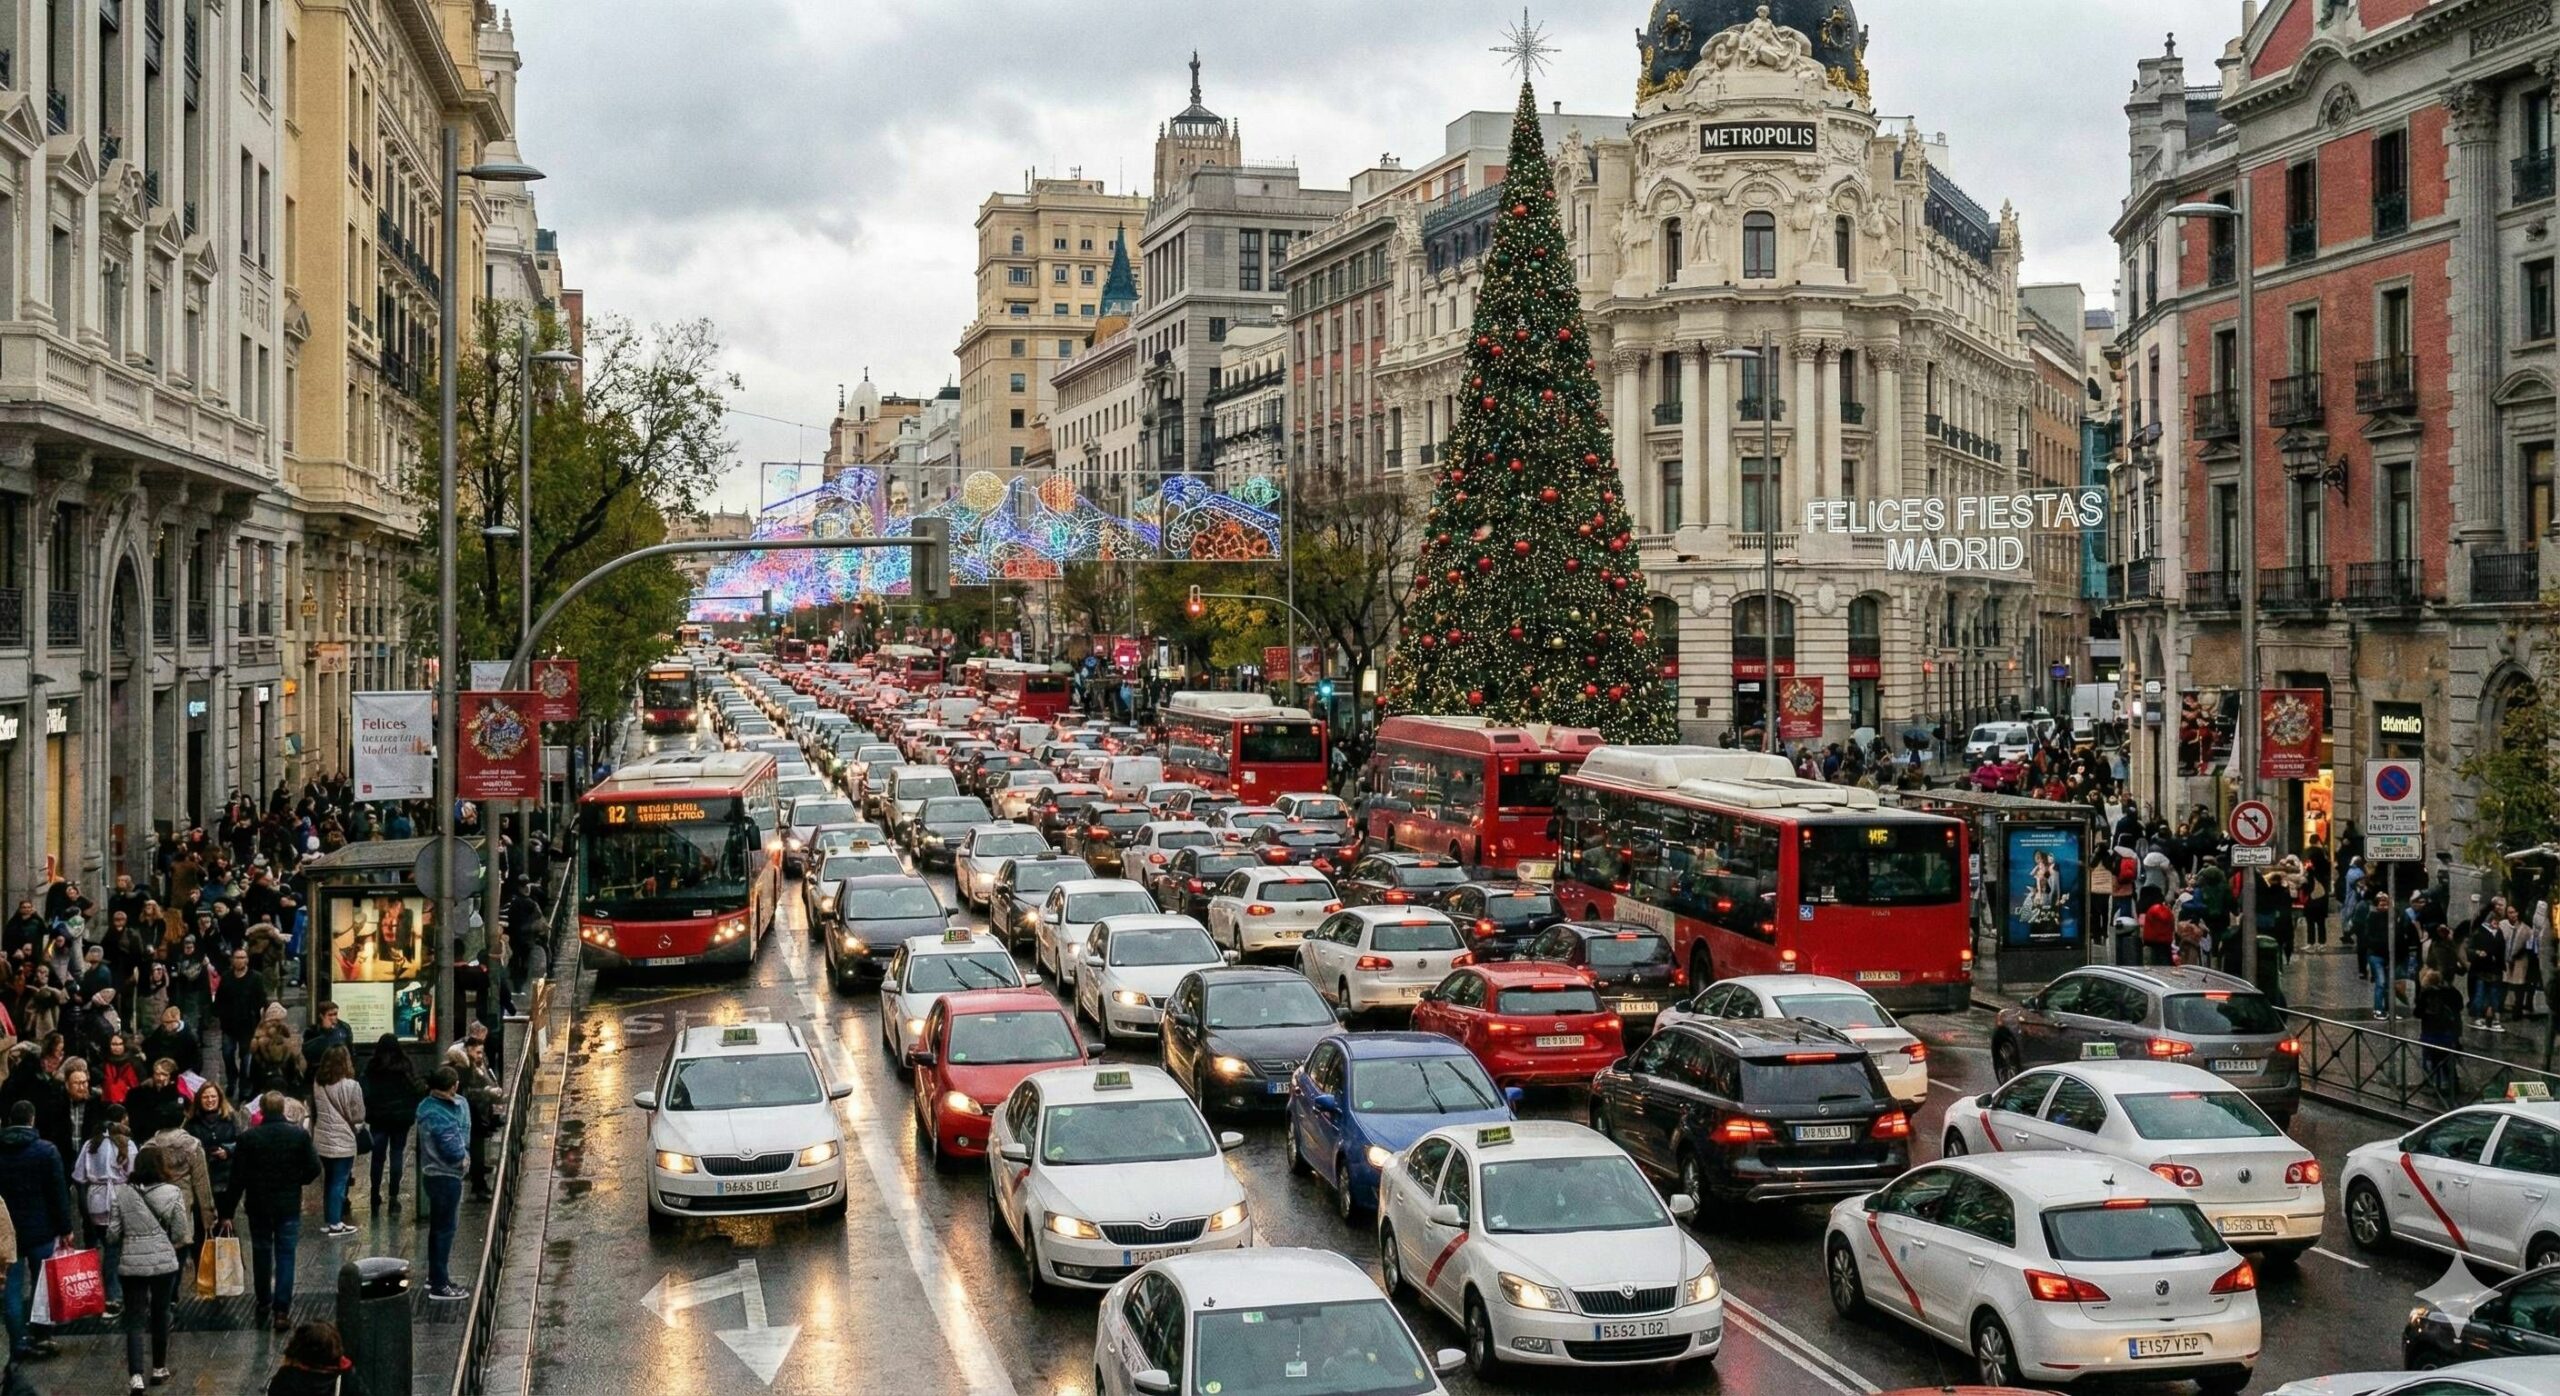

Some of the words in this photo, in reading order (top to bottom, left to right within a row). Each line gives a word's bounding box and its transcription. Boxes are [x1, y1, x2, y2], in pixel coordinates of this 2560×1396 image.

[1704, 127, 1814, 147] METROPOLIS
[1807, 499, 1945, 533] FELICES
[1957, 491, 2103, 530] FIESTAS
[1887, 536, 2024, 571] MADRID
[362, 718, 407, 730] Felices
